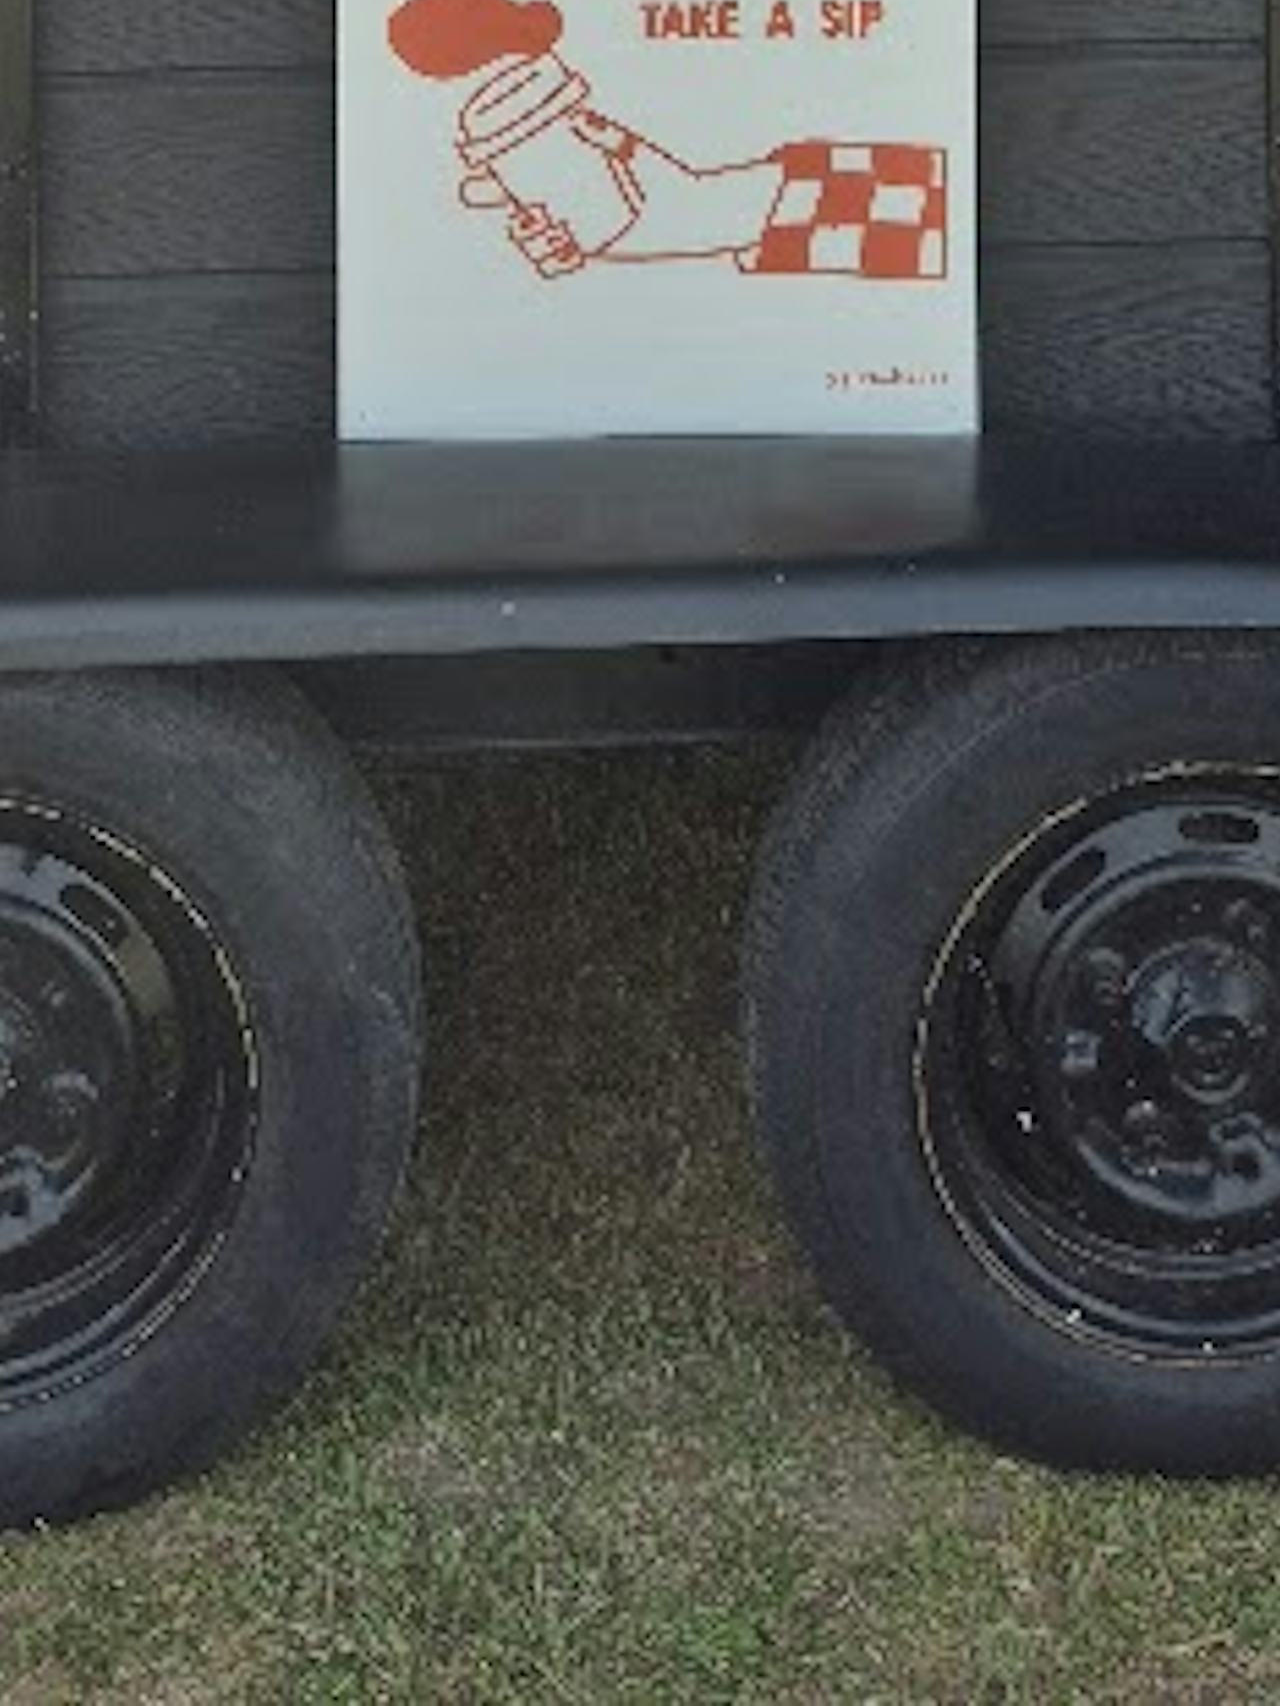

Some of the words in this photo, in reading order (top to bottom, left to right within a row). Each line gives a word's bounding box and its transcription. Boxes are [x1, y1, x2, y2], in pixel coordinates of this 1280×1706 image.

[640, 1, 739, 38] TAKE
[767, 1, 796, 38] A
[821, 0, 883, 37] SIP
